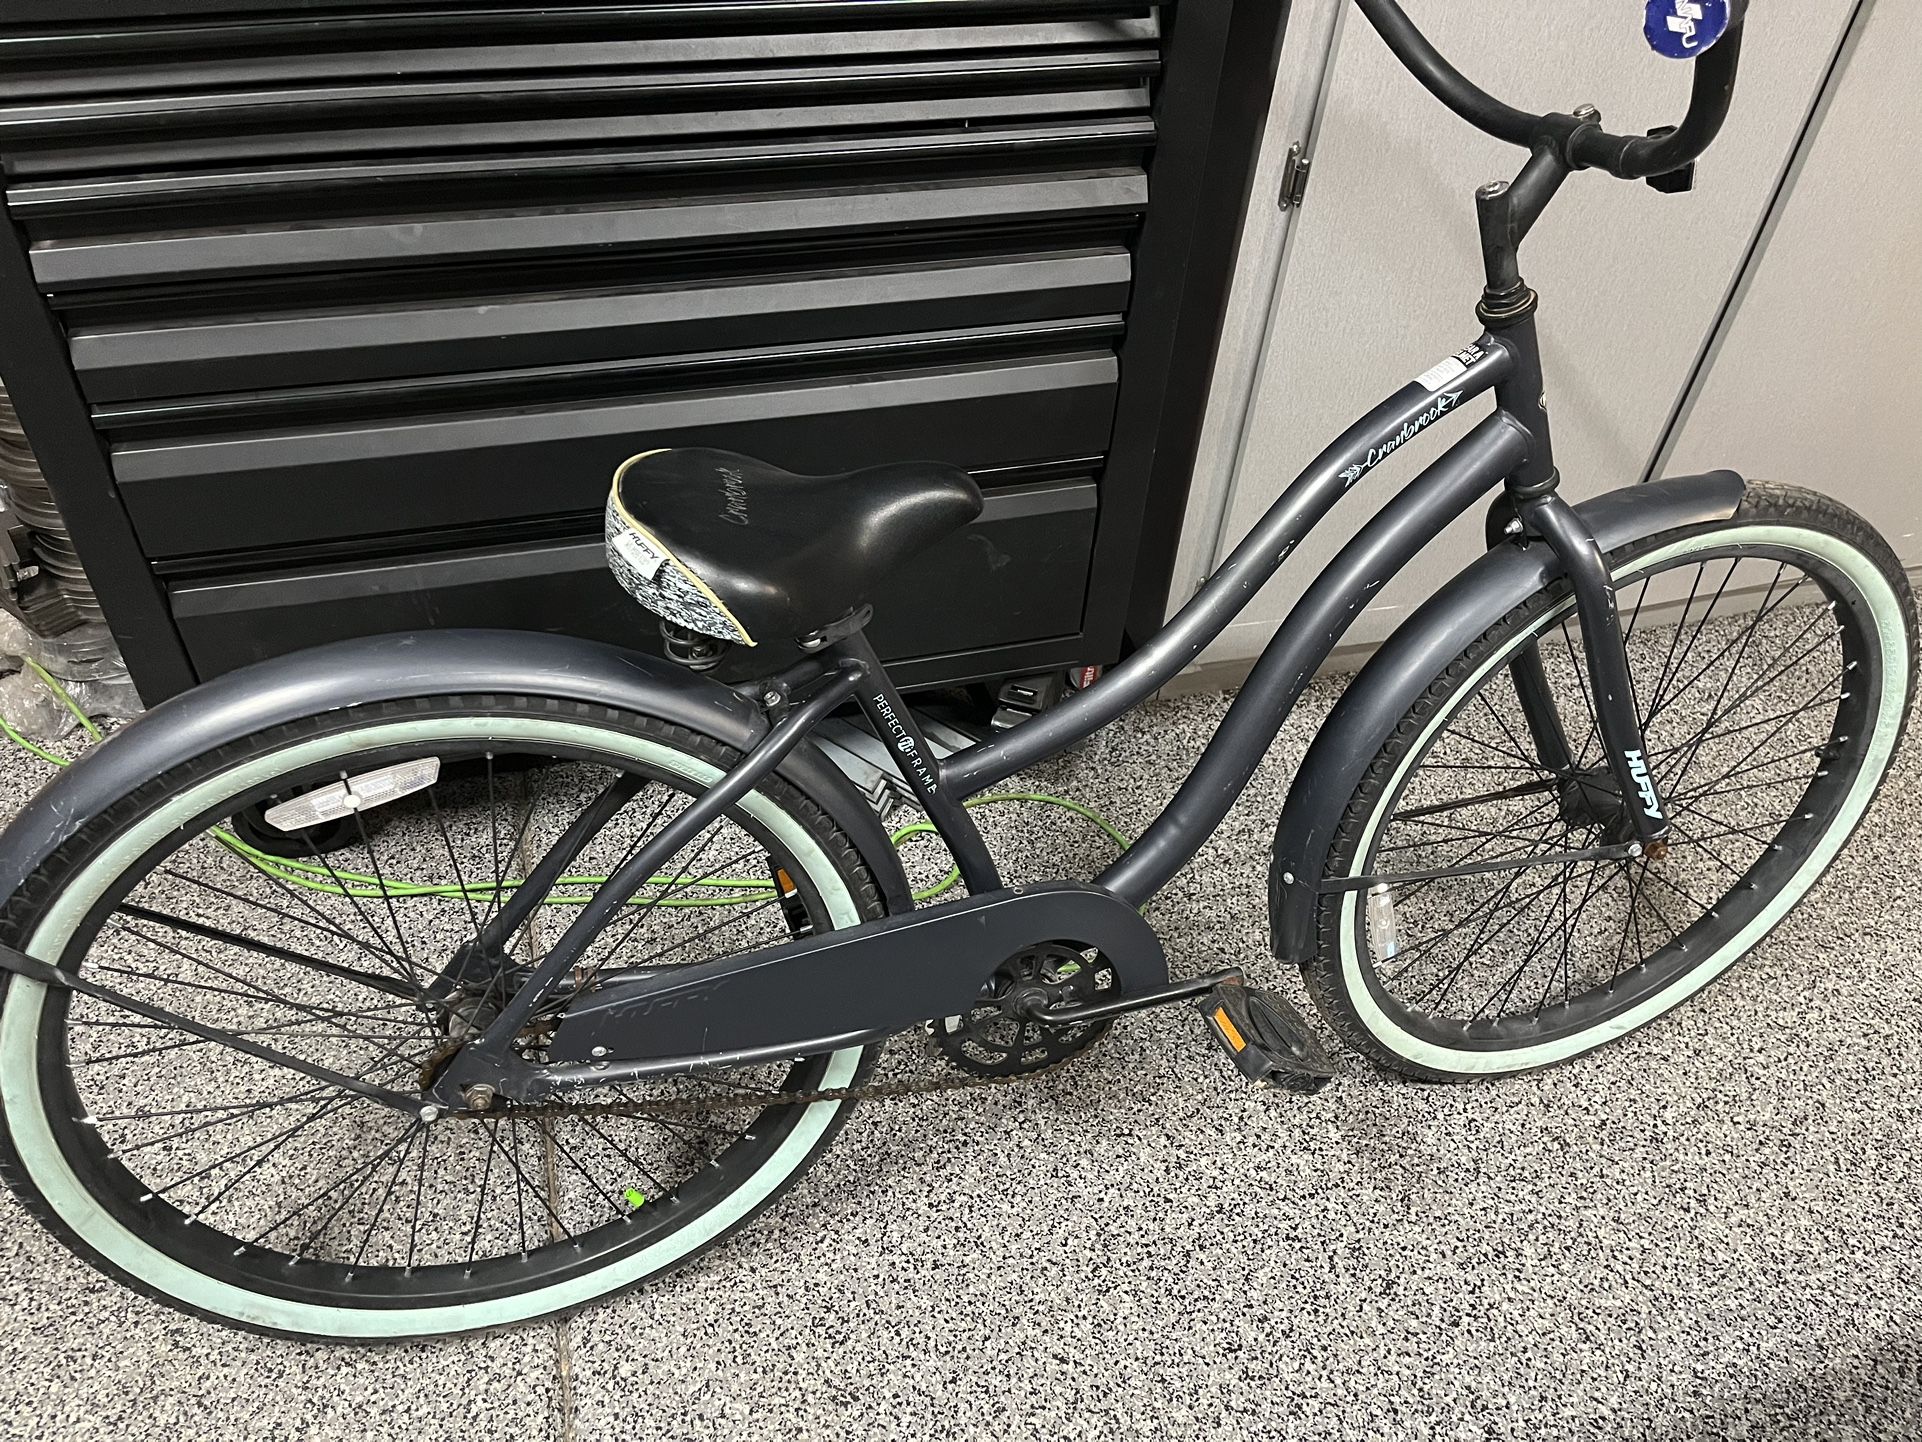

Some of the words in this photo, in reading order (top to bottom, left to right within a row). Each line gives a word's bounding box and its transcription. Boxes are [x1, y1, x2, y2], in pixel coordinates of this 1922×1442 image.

[1367, 397, 1450, 467] Cranbrook
[629, 532, 660, 560] HUFFY
[873, 693, 907, 738] PERFECT
[906, 750, 938, 795] FRAME
[1623, 749, 1664, 820] HUFFY
